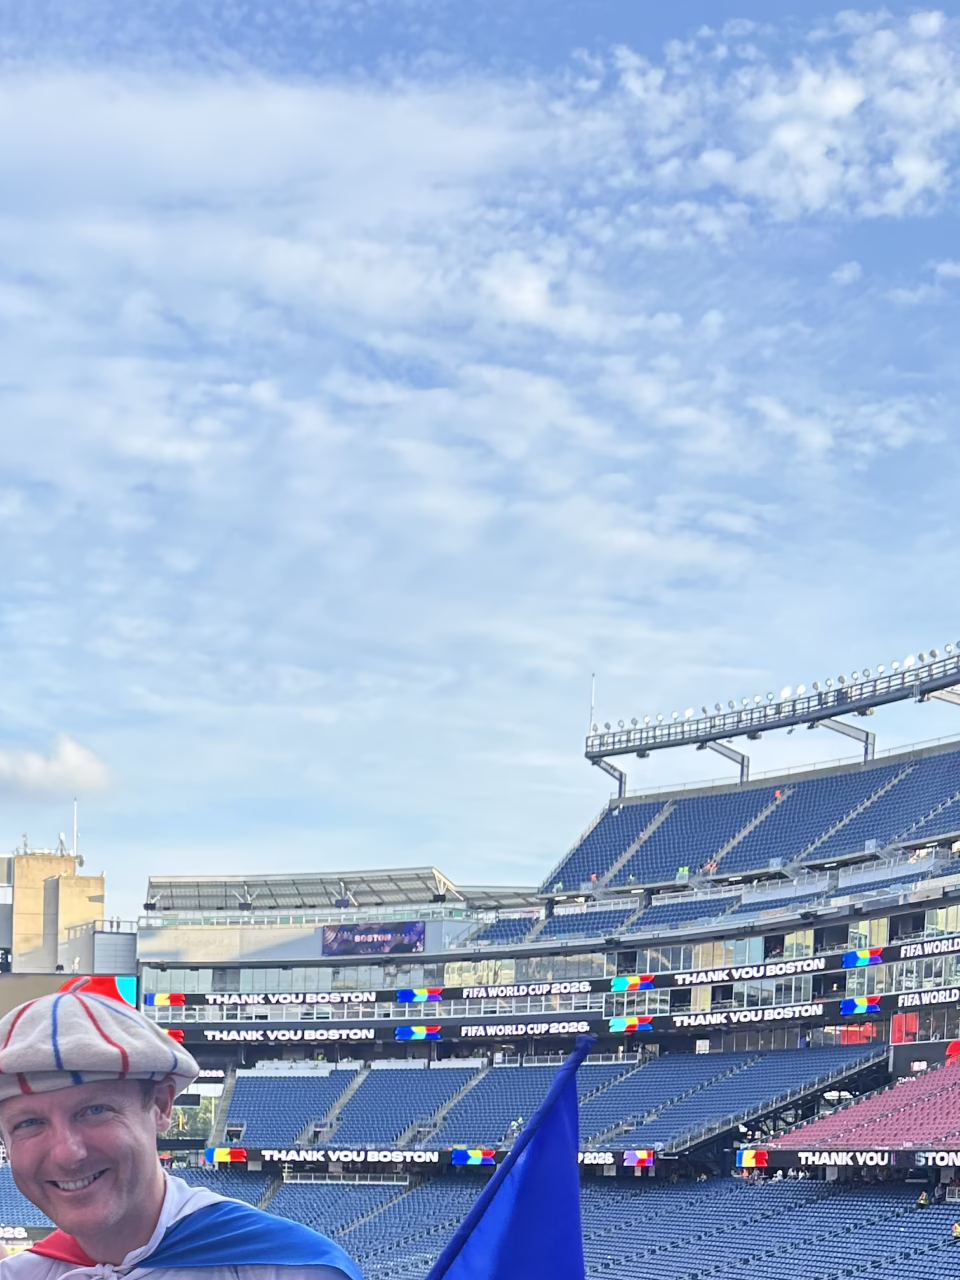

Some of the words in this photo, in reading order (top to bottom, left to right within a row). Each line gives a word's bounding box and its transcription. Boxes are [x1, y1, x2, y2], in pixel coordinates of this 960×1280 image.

[354, 934, 392, 943] BOSTON
[900, 943, 923, 958] FIFA
[924, 938, 960, 955] WORLD
[674, 968, 729, 985] THANK
[731, 965, 765, 979] YOU
[766, 958, 825, 977] BOSTON
[205, 994, 265, 1004] THANK
[267, 993, 304, 1004] YOU
[305, 992, 376, 1003] BOSTON
[462, 987, 487, 999] FIFA
[487, 985, 527, 998] WORLD
[528, 984, 550, 995] CUP
[551, 982, 589, 994] 2026
[897, 993, 921, 1008] FIFA
[921, 989, 960, 1004] WORLD
[672, 1011, 727, 1028] THANK
[729, 1008, 762, 1023] YOU
[764, 1004, 823, 1021] BOSTON
[204, 1030, 264, 1041] THANK
[266, 1030, 302, 1041] YOU
[304, 1029, 375, 1040] BOSTON
[461, 1025, 485, 1037] FIFA
[485, 1024, 526, 1036] WORLD
[526, 1023, 548, 1034] CUP
[549, 1021, 588, 1033] 2026
[261, 1150, 325, 1162] THANK
[328, 1150, 365, 1162] YOU
[367, 1150, 439, 1163] BOSTON
[583, 1152, 614, 1165] 2026
[798, 1151, 854, 1166] THANK
[856, 1151, 889, 1166] YOU
